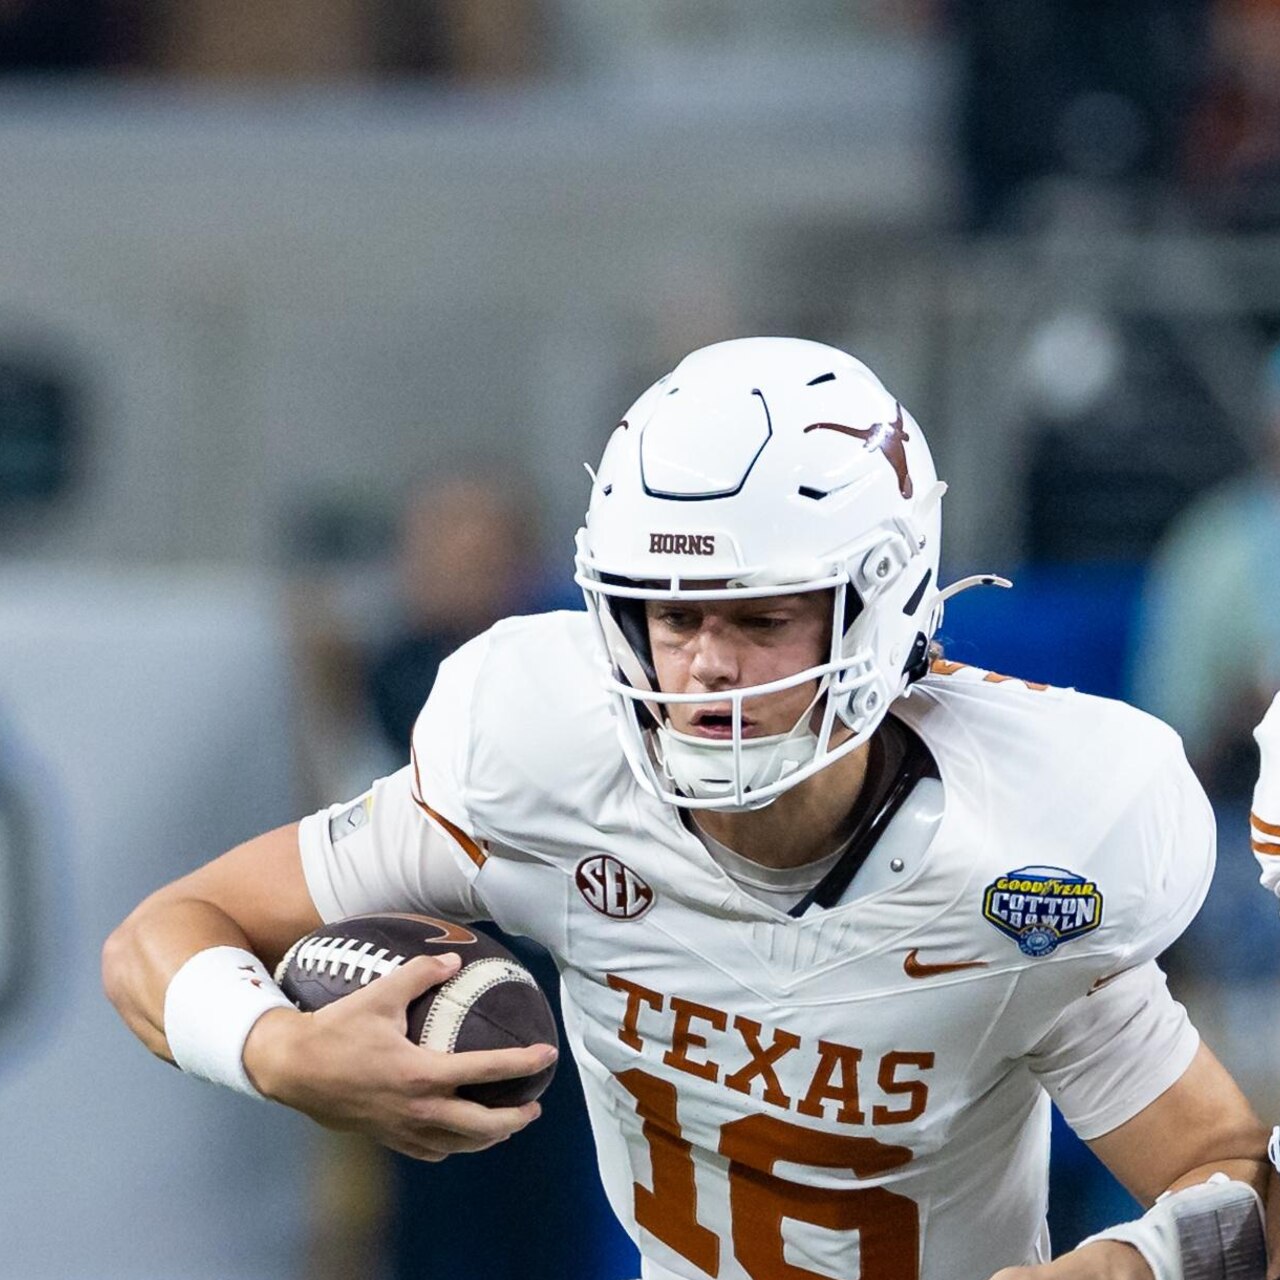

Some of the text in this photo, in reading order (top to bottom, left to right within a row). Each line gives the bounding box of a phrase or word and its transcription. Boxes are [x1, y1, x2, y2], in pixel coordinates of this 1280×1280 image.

[649, 532, 715, 556] HORNS
[581, 857, 649, 917] SEC
[996, 879, 1095, 896] GOODYEAR
[991, 891, 1097, 927] COTTON
[1009, 911, 1075, 931] BOWL
[605, 973, 936, 1126] TEXAS
